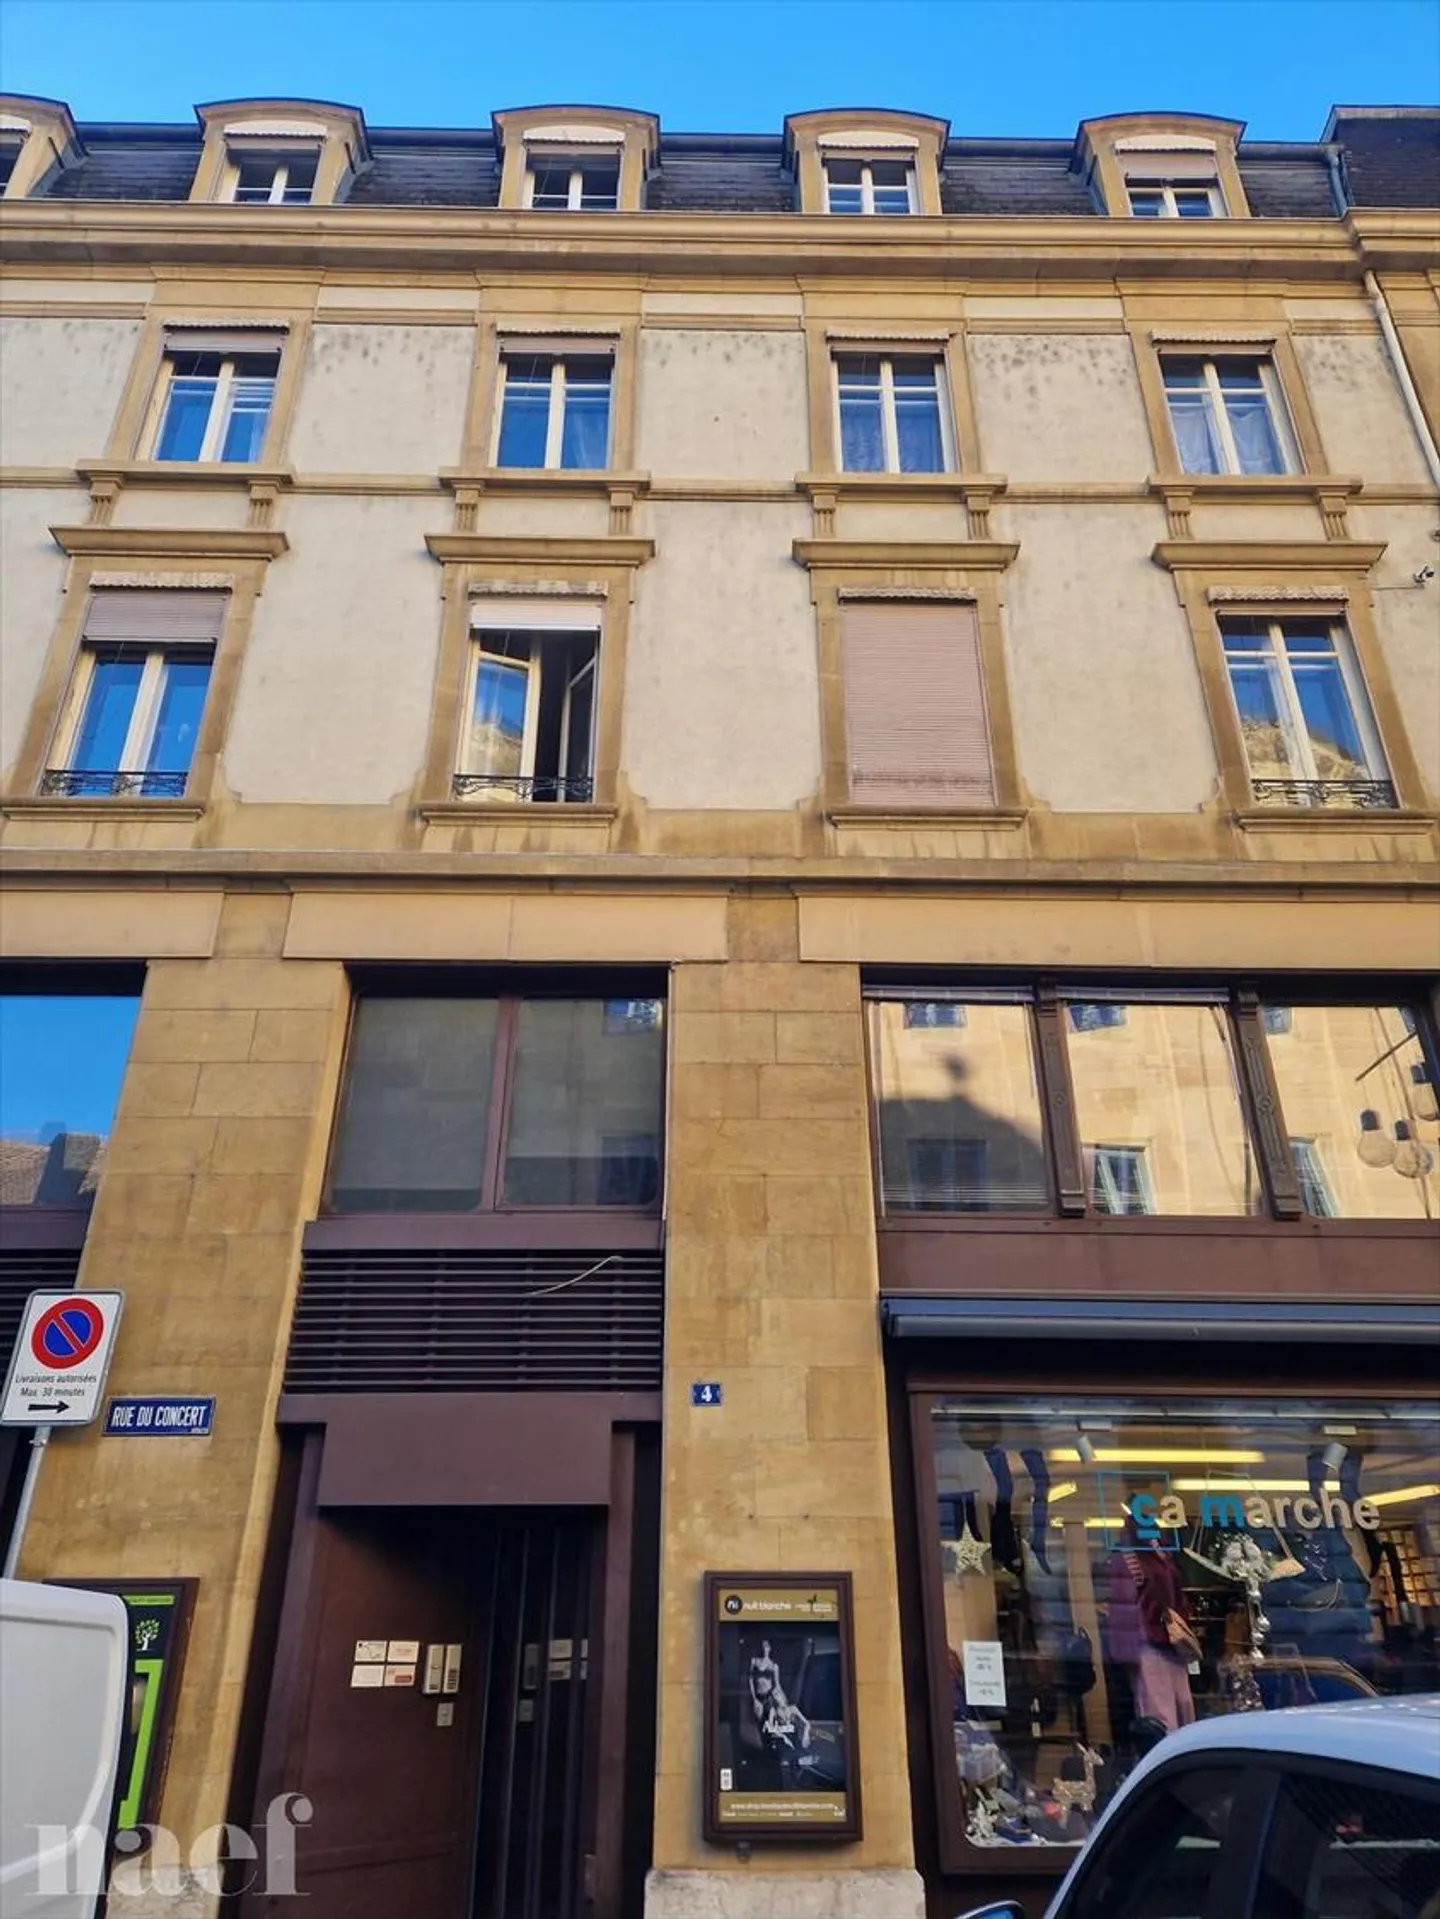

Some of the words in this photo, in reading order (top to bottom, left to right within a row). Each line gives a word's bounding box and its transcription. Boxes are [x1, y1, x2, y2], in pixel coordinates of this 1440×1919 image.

[15, 1373, 54, 1383] Livraisons
[56, 1373, 97, 1382] autorisées
[42, 1387, 53, 1396] 30
[54, 1387, 85, 1396] minutes
[701, 1385, 712, 1402] 4
[111, 1406, 136, 1427] RUE
[136, 1406, 153, 1427] DU
[155, 1405, 207, 1426] CONCERT
[1130, 1493, 1187, 1539] ça
[1201, 1487, 1380, 1530] marche
